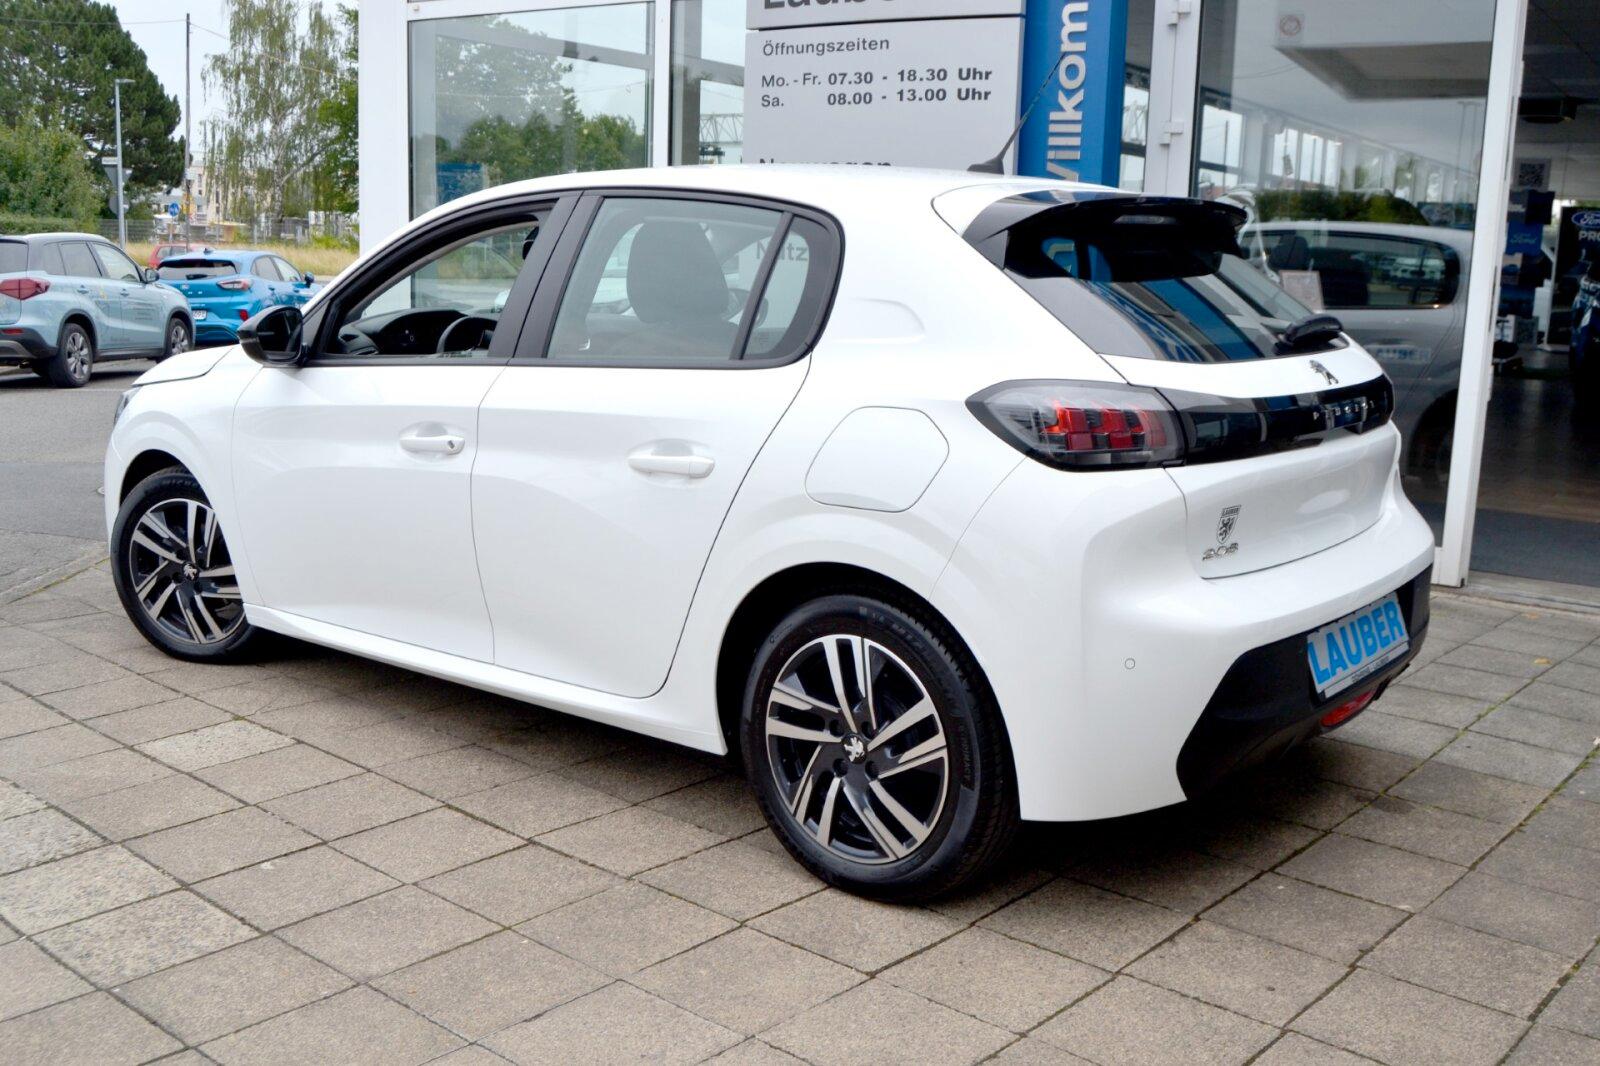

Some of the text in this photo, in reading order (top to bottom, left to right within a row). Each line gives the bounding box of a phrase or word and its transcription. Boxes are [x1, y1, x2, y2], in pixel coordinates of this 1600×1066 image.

[762, 38, 890, 56] Öffnungszeiten
[761, 74, 790, 88] Mo.
[802, 72, 821, 86] Fr.
[827, 71, 874, 86] 07.30
[897, 68, 948, 82] 18.30
[958, 67, 992, 81] Uhr
[761, 94, 784, 107] Sa.
[827, 92, 873, 106] 08.00
[896, 88, 947, 102] 13.00
[957, 87, 992, 101] Uhr
[1307, 601, 1405, 684] LAUBER
